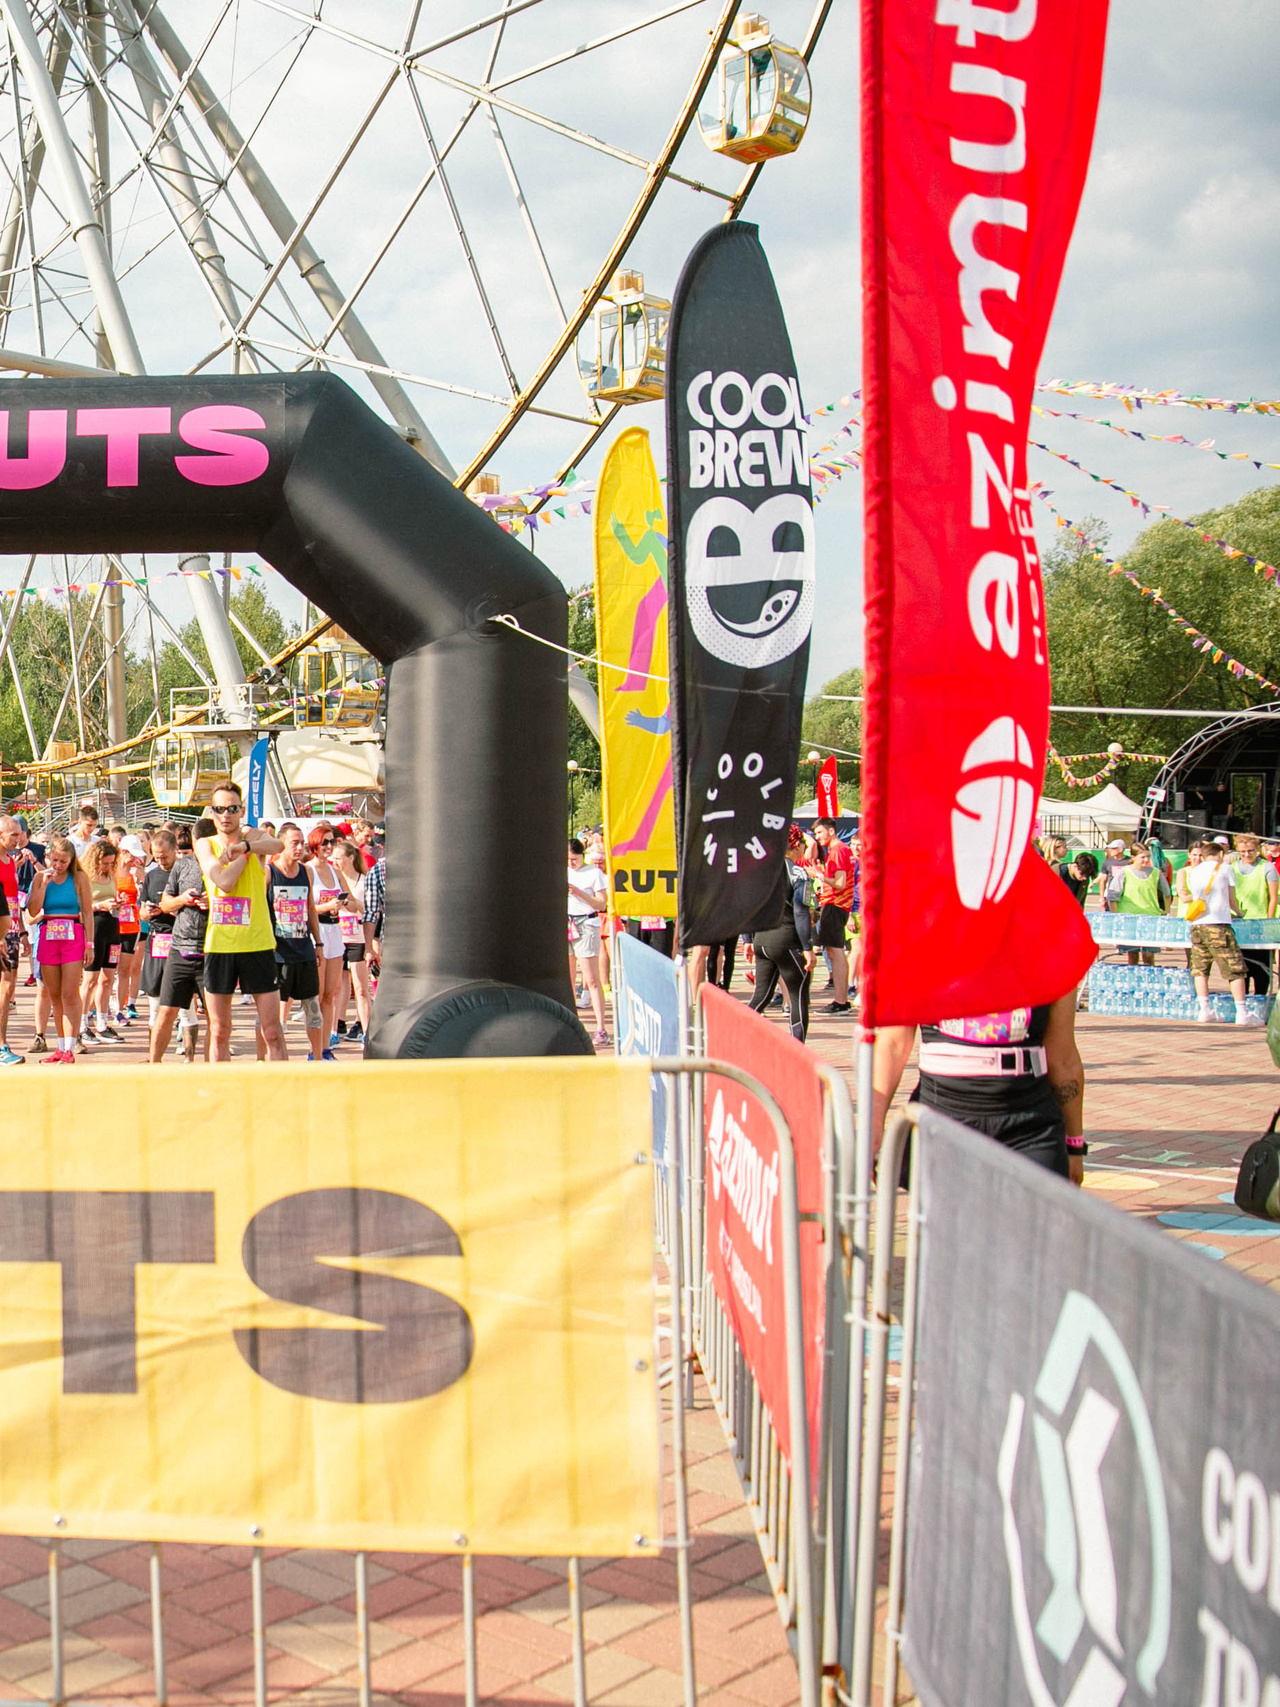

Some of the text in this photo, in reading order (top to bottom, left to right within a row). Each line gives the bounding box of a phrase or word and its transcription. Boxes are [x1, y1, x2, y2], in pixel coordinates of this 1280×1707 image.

[686, 370, 808, 429] COOL
[687, 429, 810, 488] BREW
[253, 760, 261, 818] GEELY
[214, 904, 232, 913] 116
[614, 869, 677, 893] RUT
